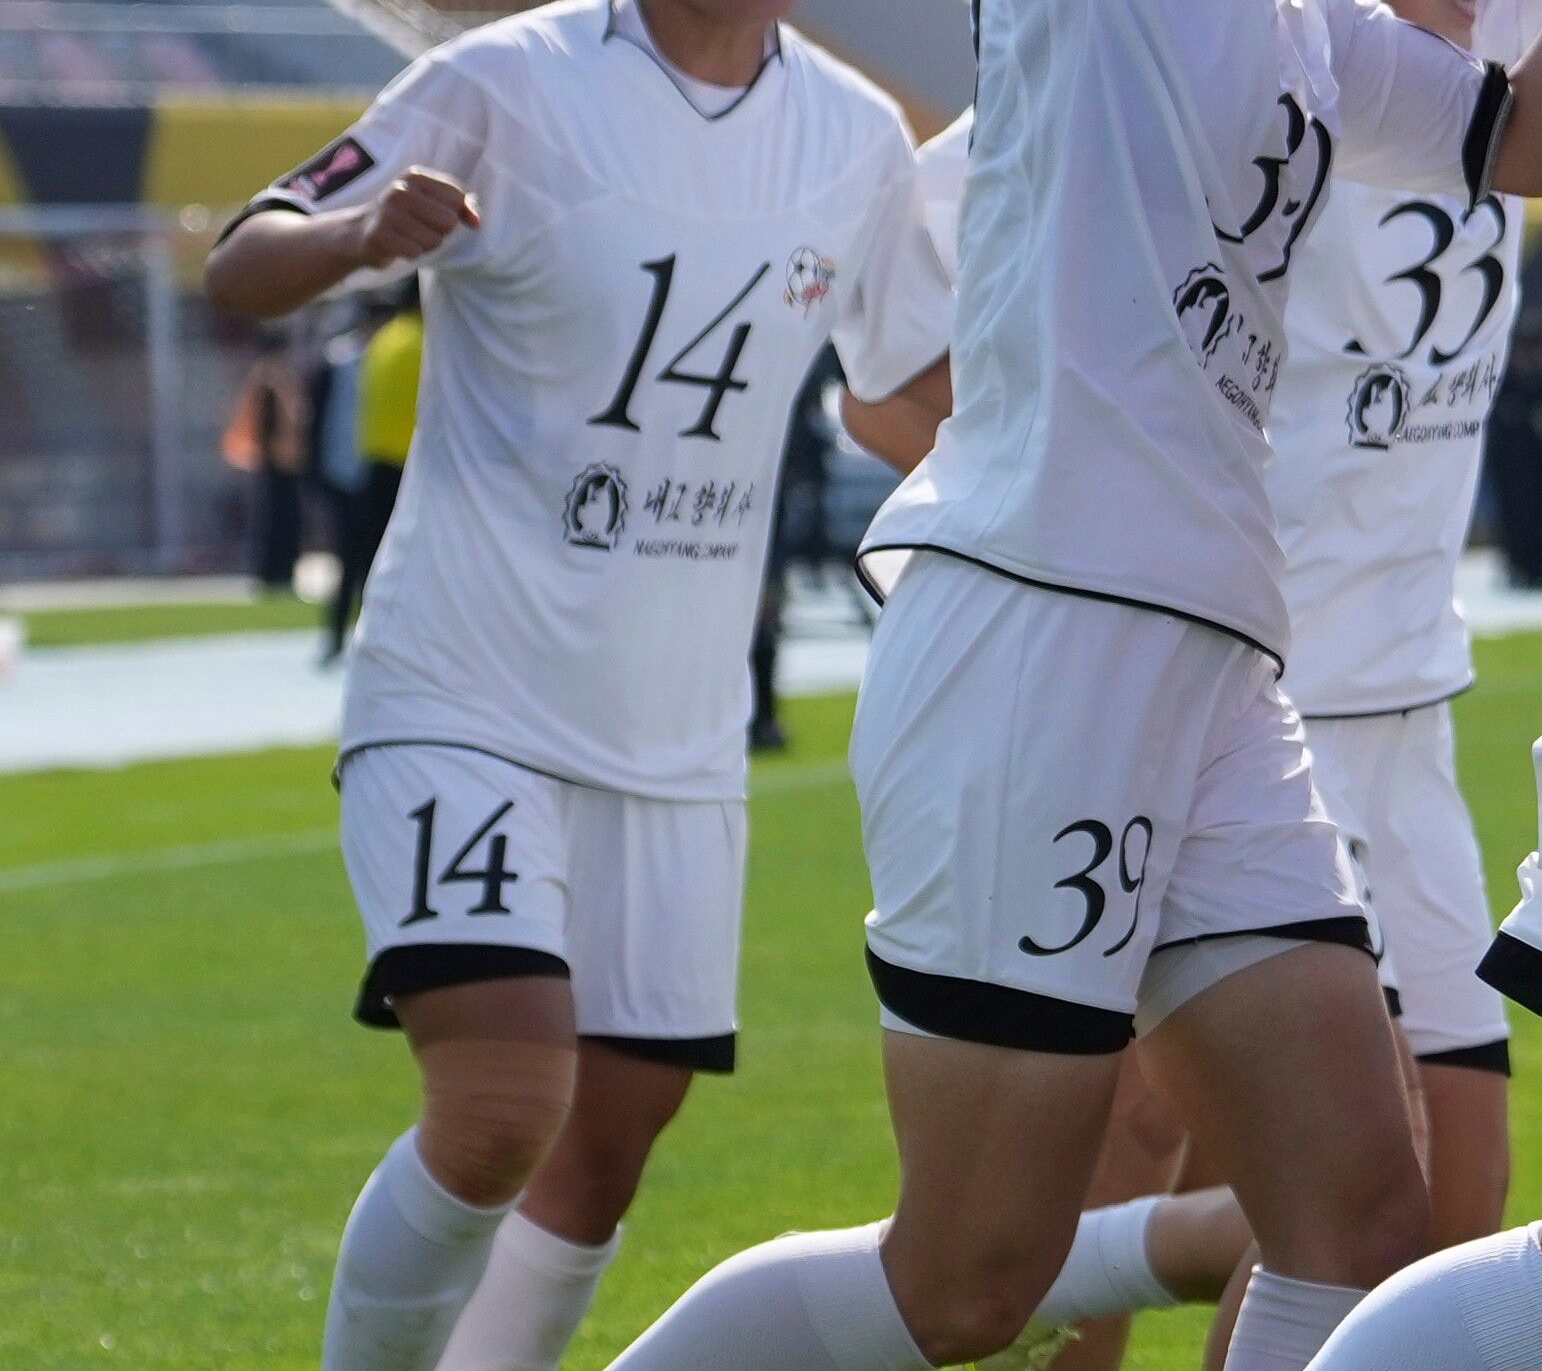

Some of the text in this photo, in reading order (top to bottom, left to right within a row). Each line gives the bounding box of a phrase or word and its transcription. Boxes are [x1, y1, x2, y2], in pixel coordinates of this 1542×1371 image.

[585, 250, 771, 443] 14
[1342, 193, 1506, 366] 33
[399, 795, 518, 927] 14
[1018, 814, 1154, 959] 39
